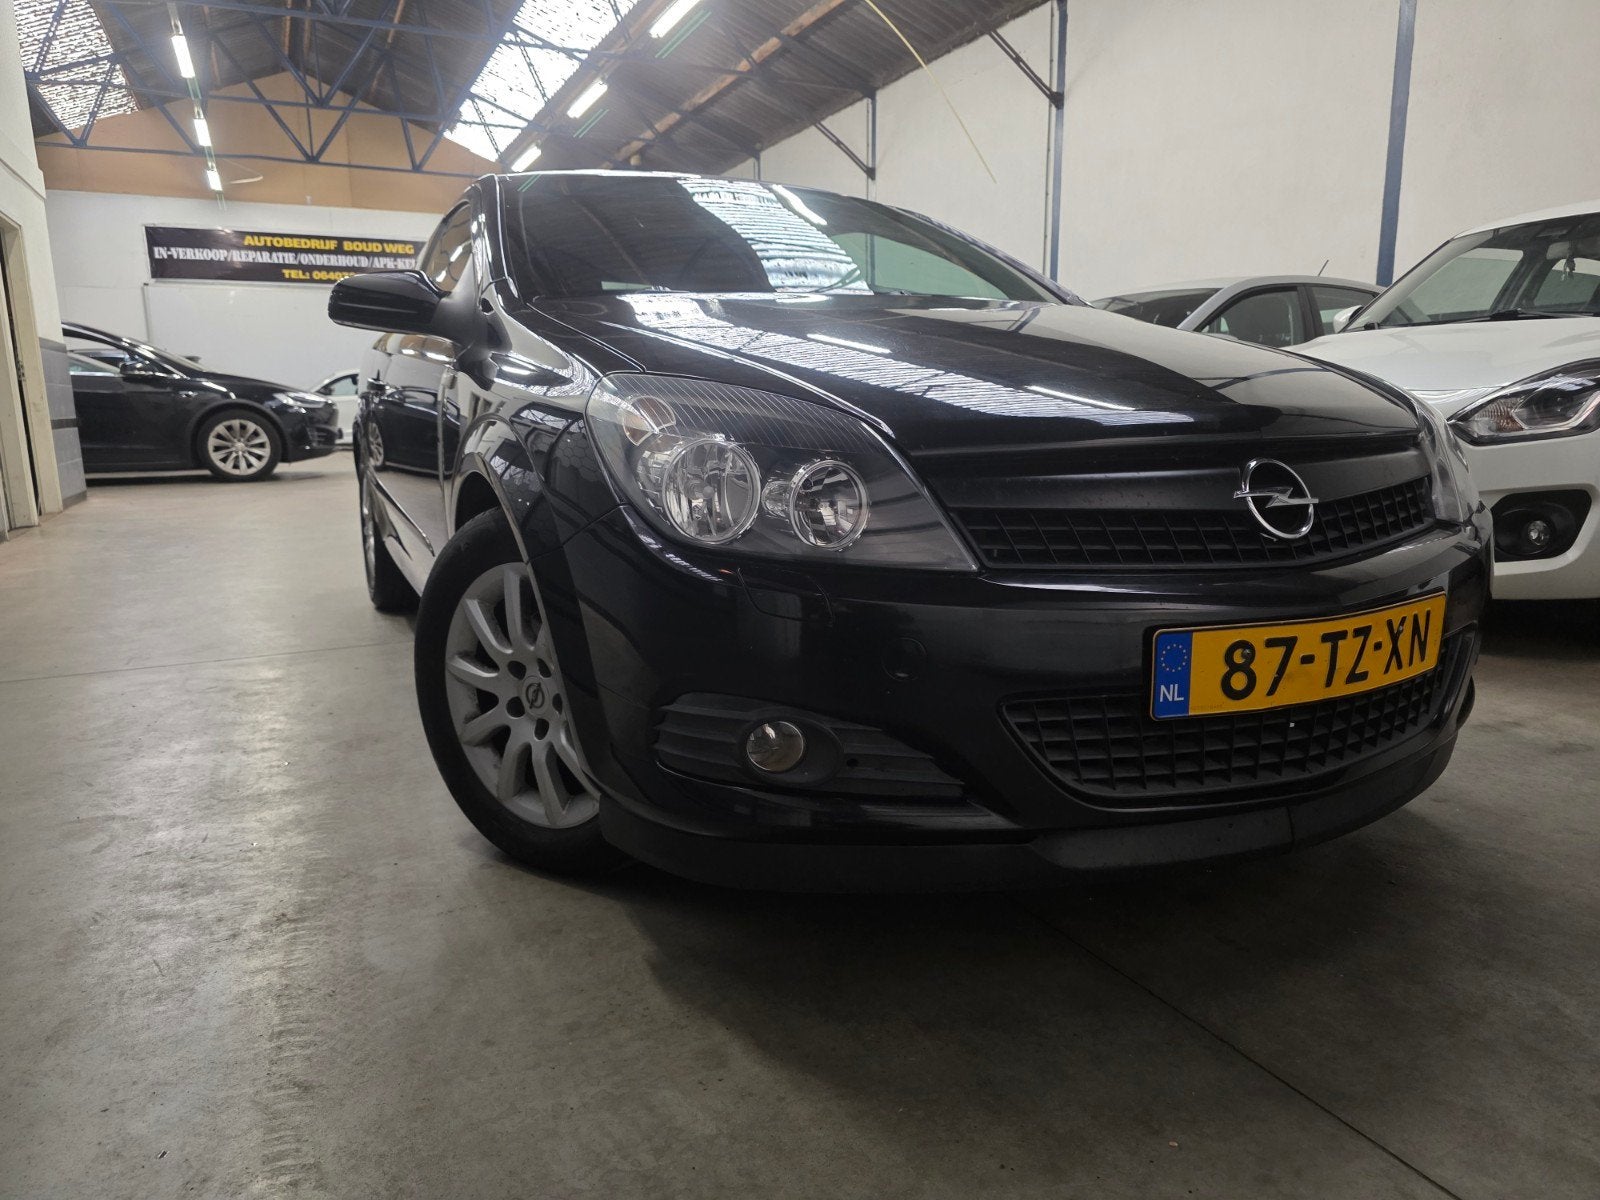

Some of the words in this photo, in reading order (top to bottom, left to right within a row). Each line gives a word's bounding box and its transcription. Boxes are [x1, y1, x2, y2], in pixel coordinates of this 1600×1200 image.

[243, 235, 338, 250] AUTOBEDRIJF
[343, 240, 382, 253] BOUD
[384, 243, 415, 255] WEG
[282, 269, 310, 280] TEL:
[1221, 609, 1431, 701] 87-TZ-XN
[1159, 684, 1185, 702] NL
